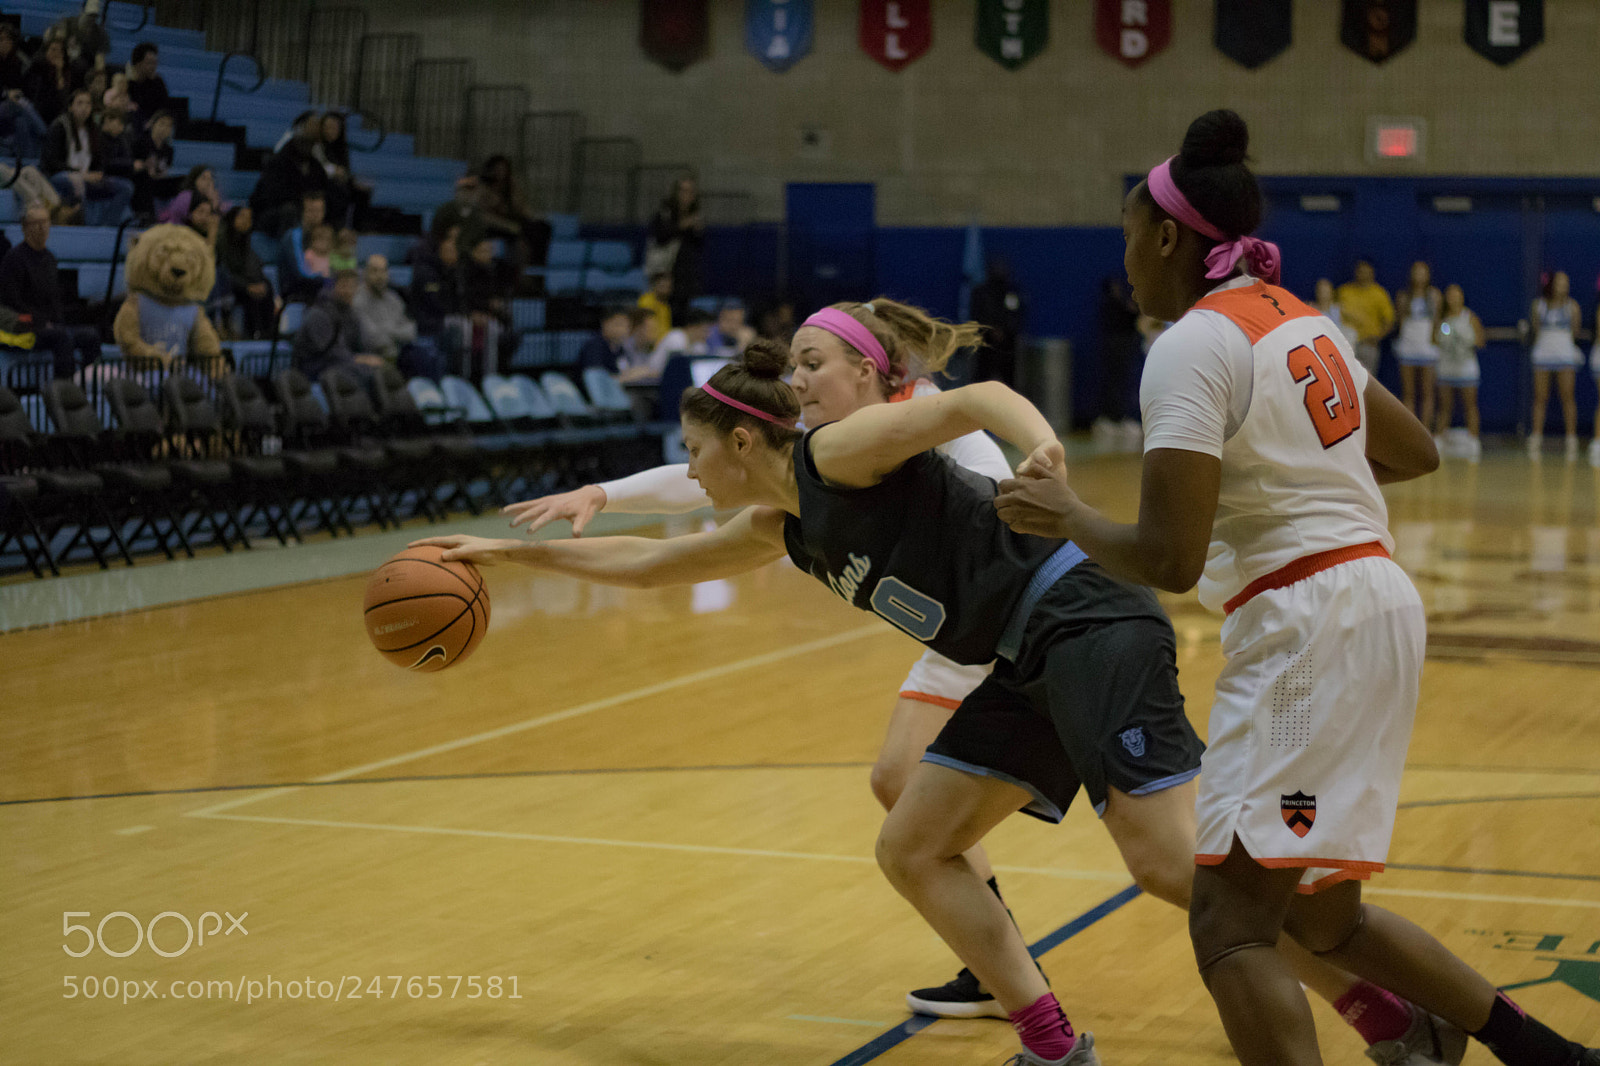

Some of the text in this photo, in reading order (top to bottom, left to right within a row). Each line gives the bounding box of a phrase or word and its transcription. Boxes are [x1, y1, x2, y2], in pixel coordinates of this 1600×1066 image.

[766, 0, 790, 58] IA
[1286, 334, 1361, 450] 20
[870, 575, 946, 641] 0
[1281, 799, 1316, 807] PRINCETON
